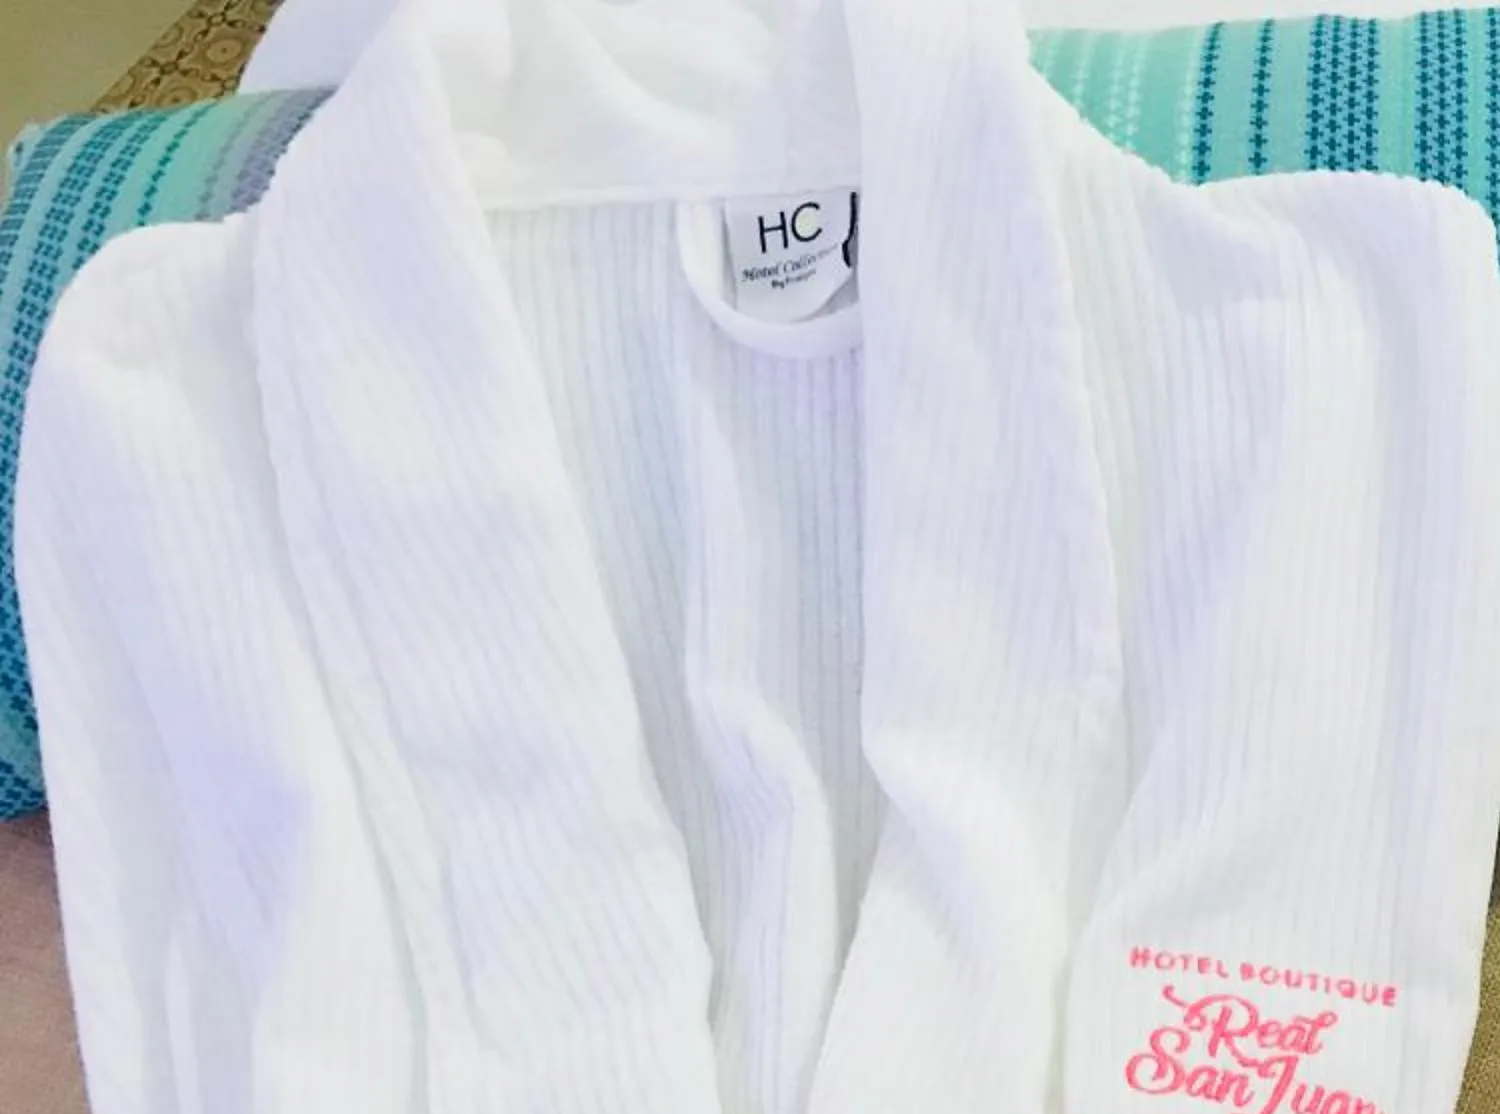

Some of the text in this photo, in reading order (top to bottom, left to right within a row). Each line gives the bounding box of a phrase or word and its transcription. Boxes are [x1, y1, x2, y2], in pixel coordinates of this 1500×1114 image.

[757, 202, 823, 253] HC
[1129, 946, 1398, 1008] HOTEL BOUTIQUE
[1126, 1027, 1254, 1108] San
